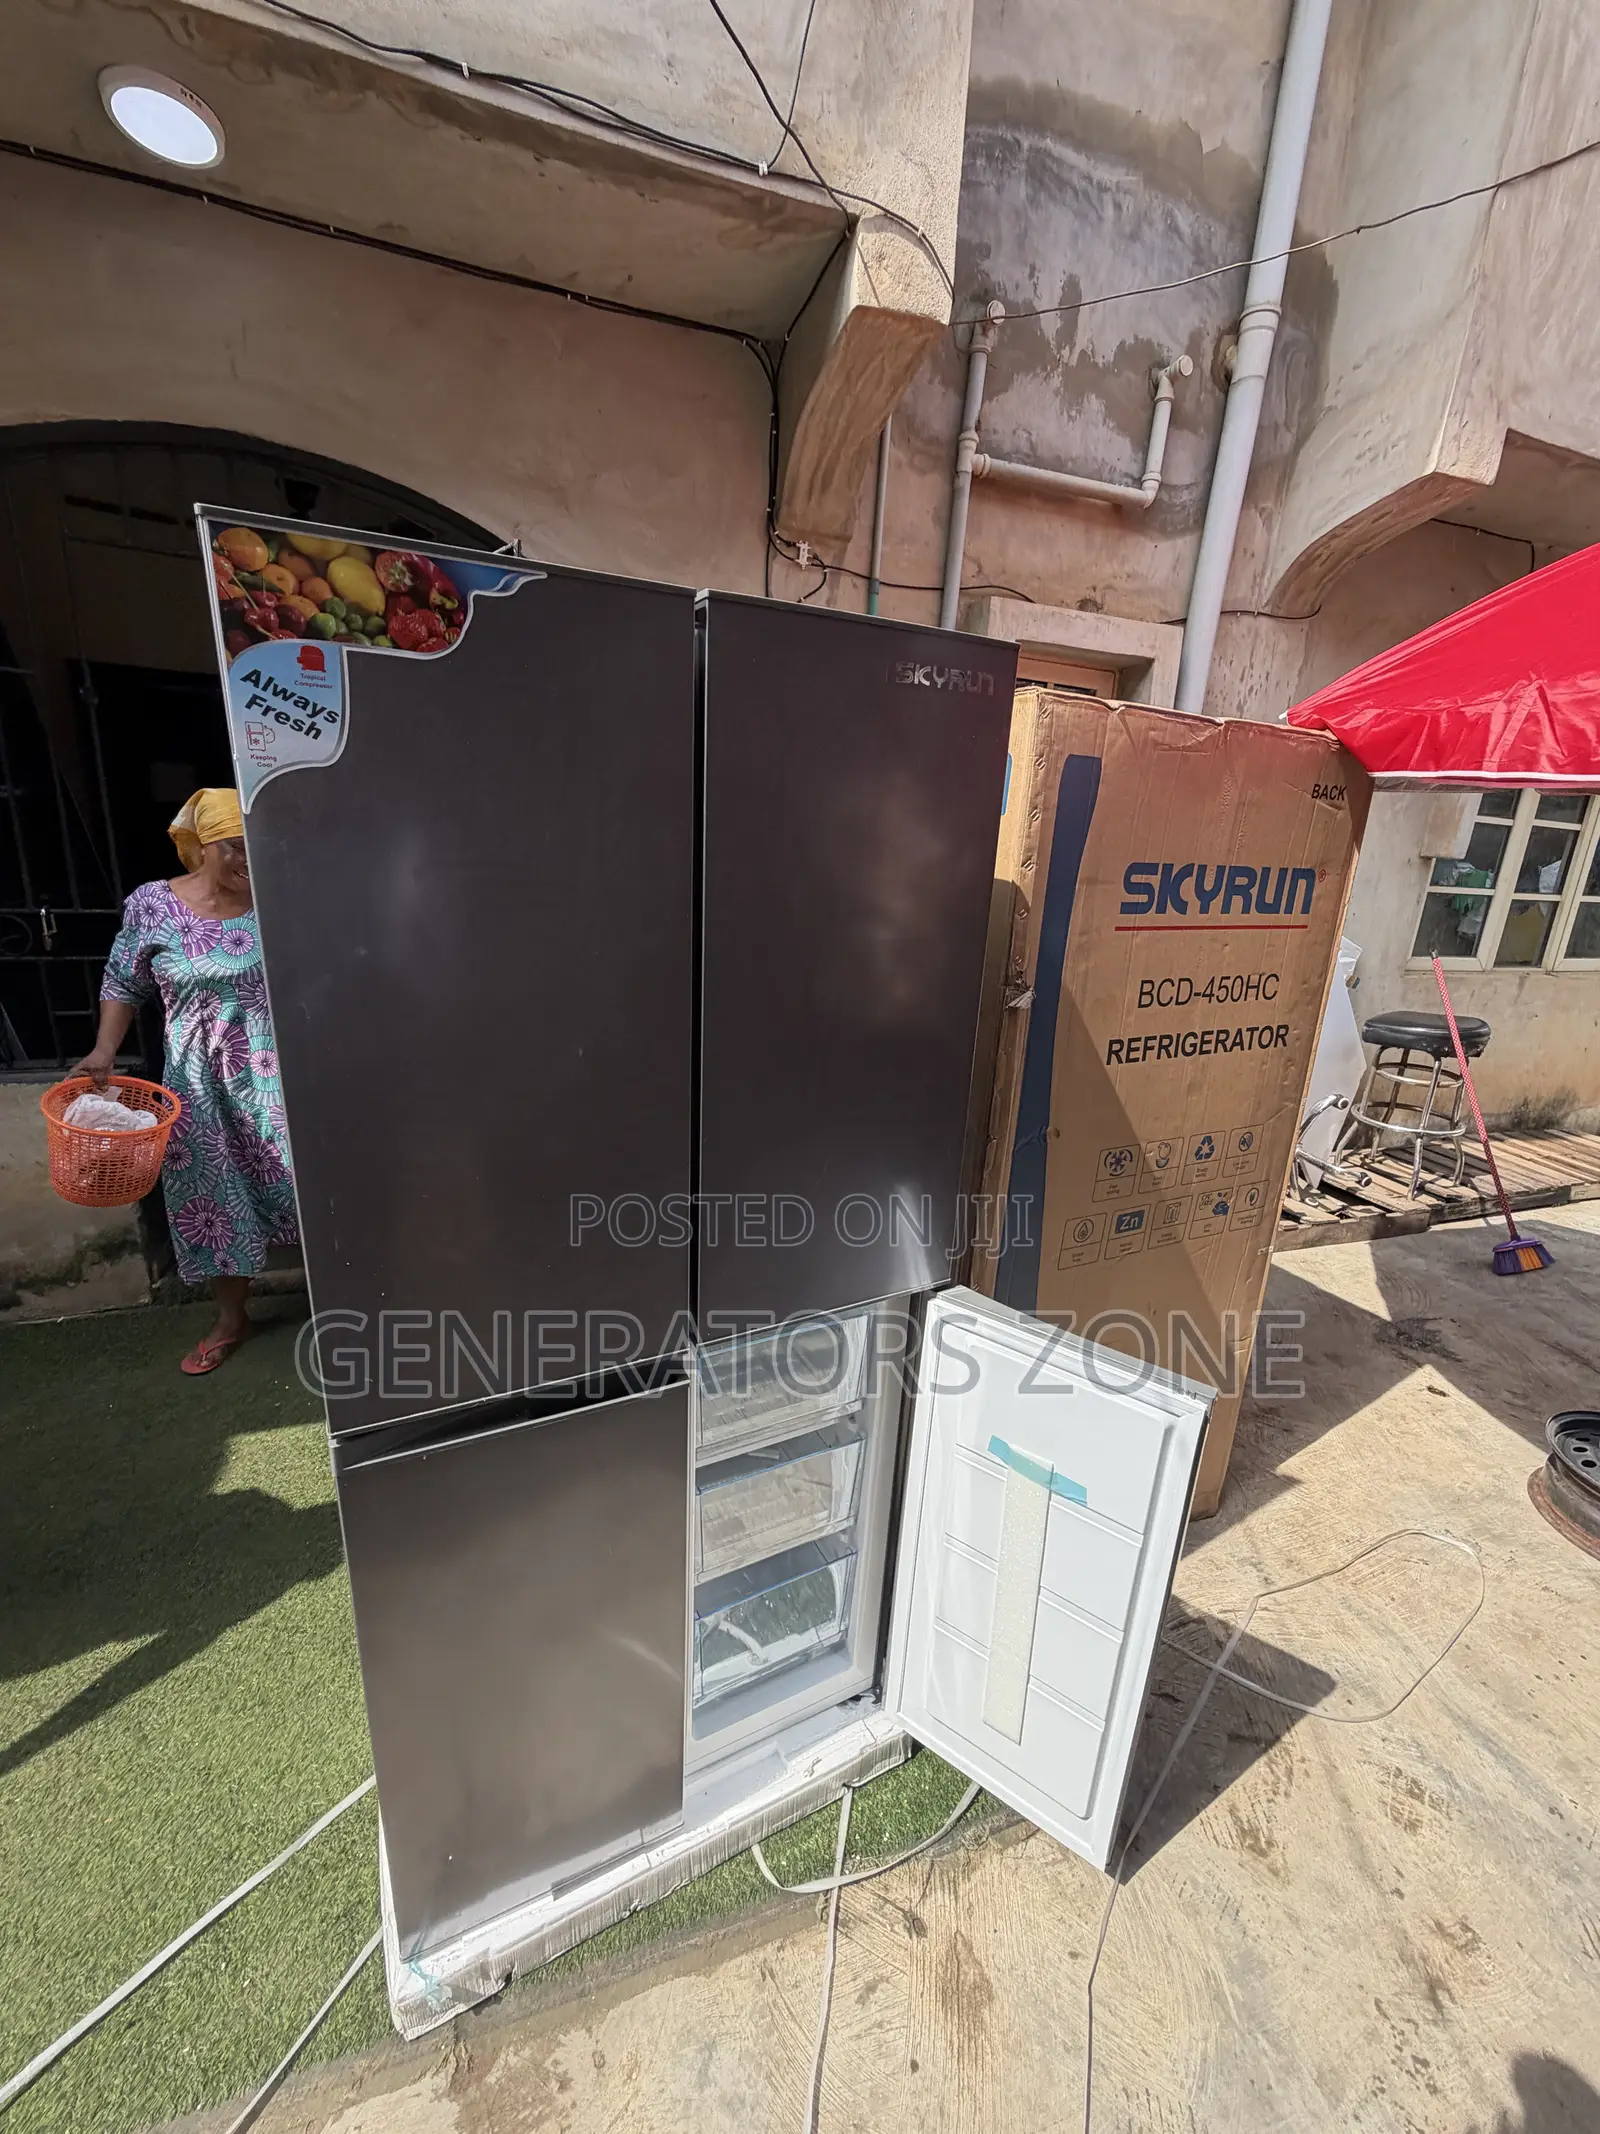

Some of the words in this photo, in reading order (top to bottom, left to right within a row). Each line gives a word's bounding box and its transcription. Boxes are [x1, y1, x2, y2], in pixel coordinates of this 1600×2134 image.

[240, 668, 340, 724] Always
[896, 660, 994, 696] SKYRUN
[245, 693, 322, 740] Fresh
[1311, 783, 1347, 801] BACK
[1119, 862, 1316, 915] SKYRUN
[1137, 973, 1280, 1009] BCD-450HC
[1106, 1024, 1290, 1066] REFRIGERATOR
[1120, 1215, 1139, 1230] Zn
